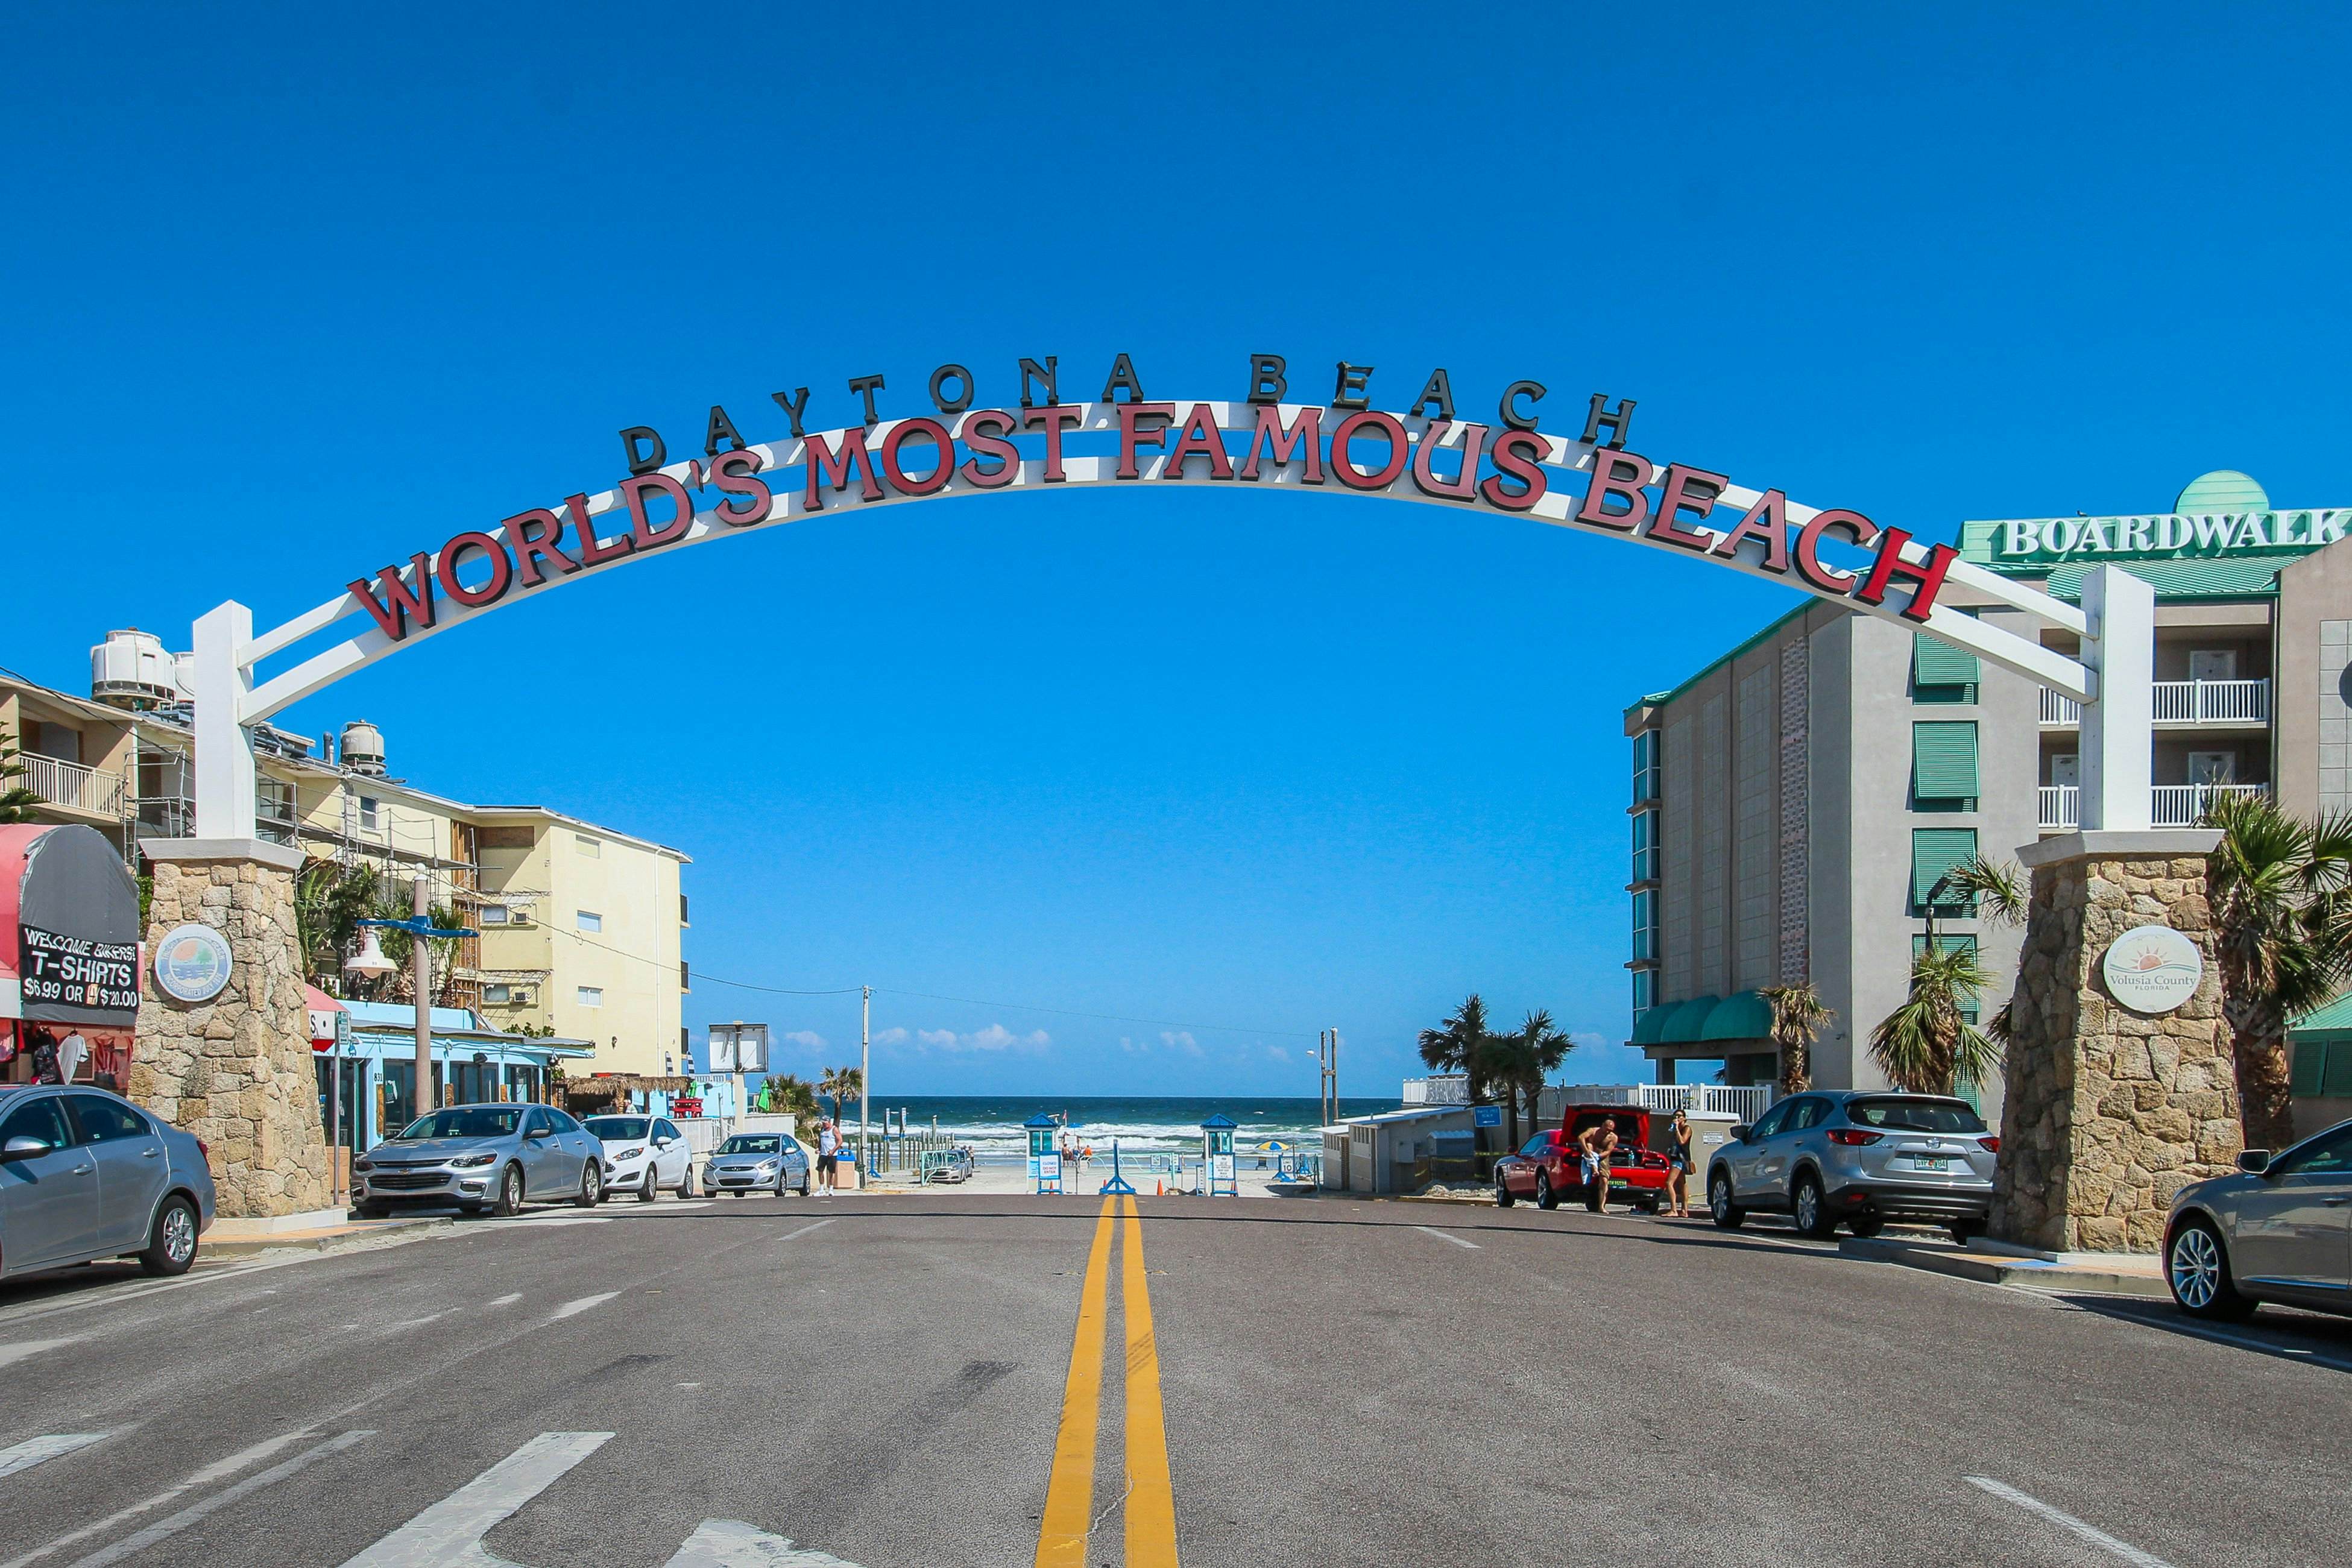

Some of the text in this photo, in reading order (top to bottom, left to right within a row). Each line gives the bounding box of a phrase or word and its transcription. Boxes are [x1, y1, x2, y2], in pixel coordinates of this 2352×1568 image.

[619, 353, 1637, 475] DAYTONA BEACH
[347, 402, 1959, 641] WORLD'S MOST FAMOUS BEACH
[2000, 510, 2345, 556] BOARDWALK
[25, 928, 136, 962] WELCOME BIKERS!
[31, 950, 131, 987] T-SHIRTS
[2111, 975, 2196, 988] Volusia County
[24, 977, 61, 1000] $6.99
[65, 984, 84, 1003] OR
[374, 1073, 383, 1082] 831
